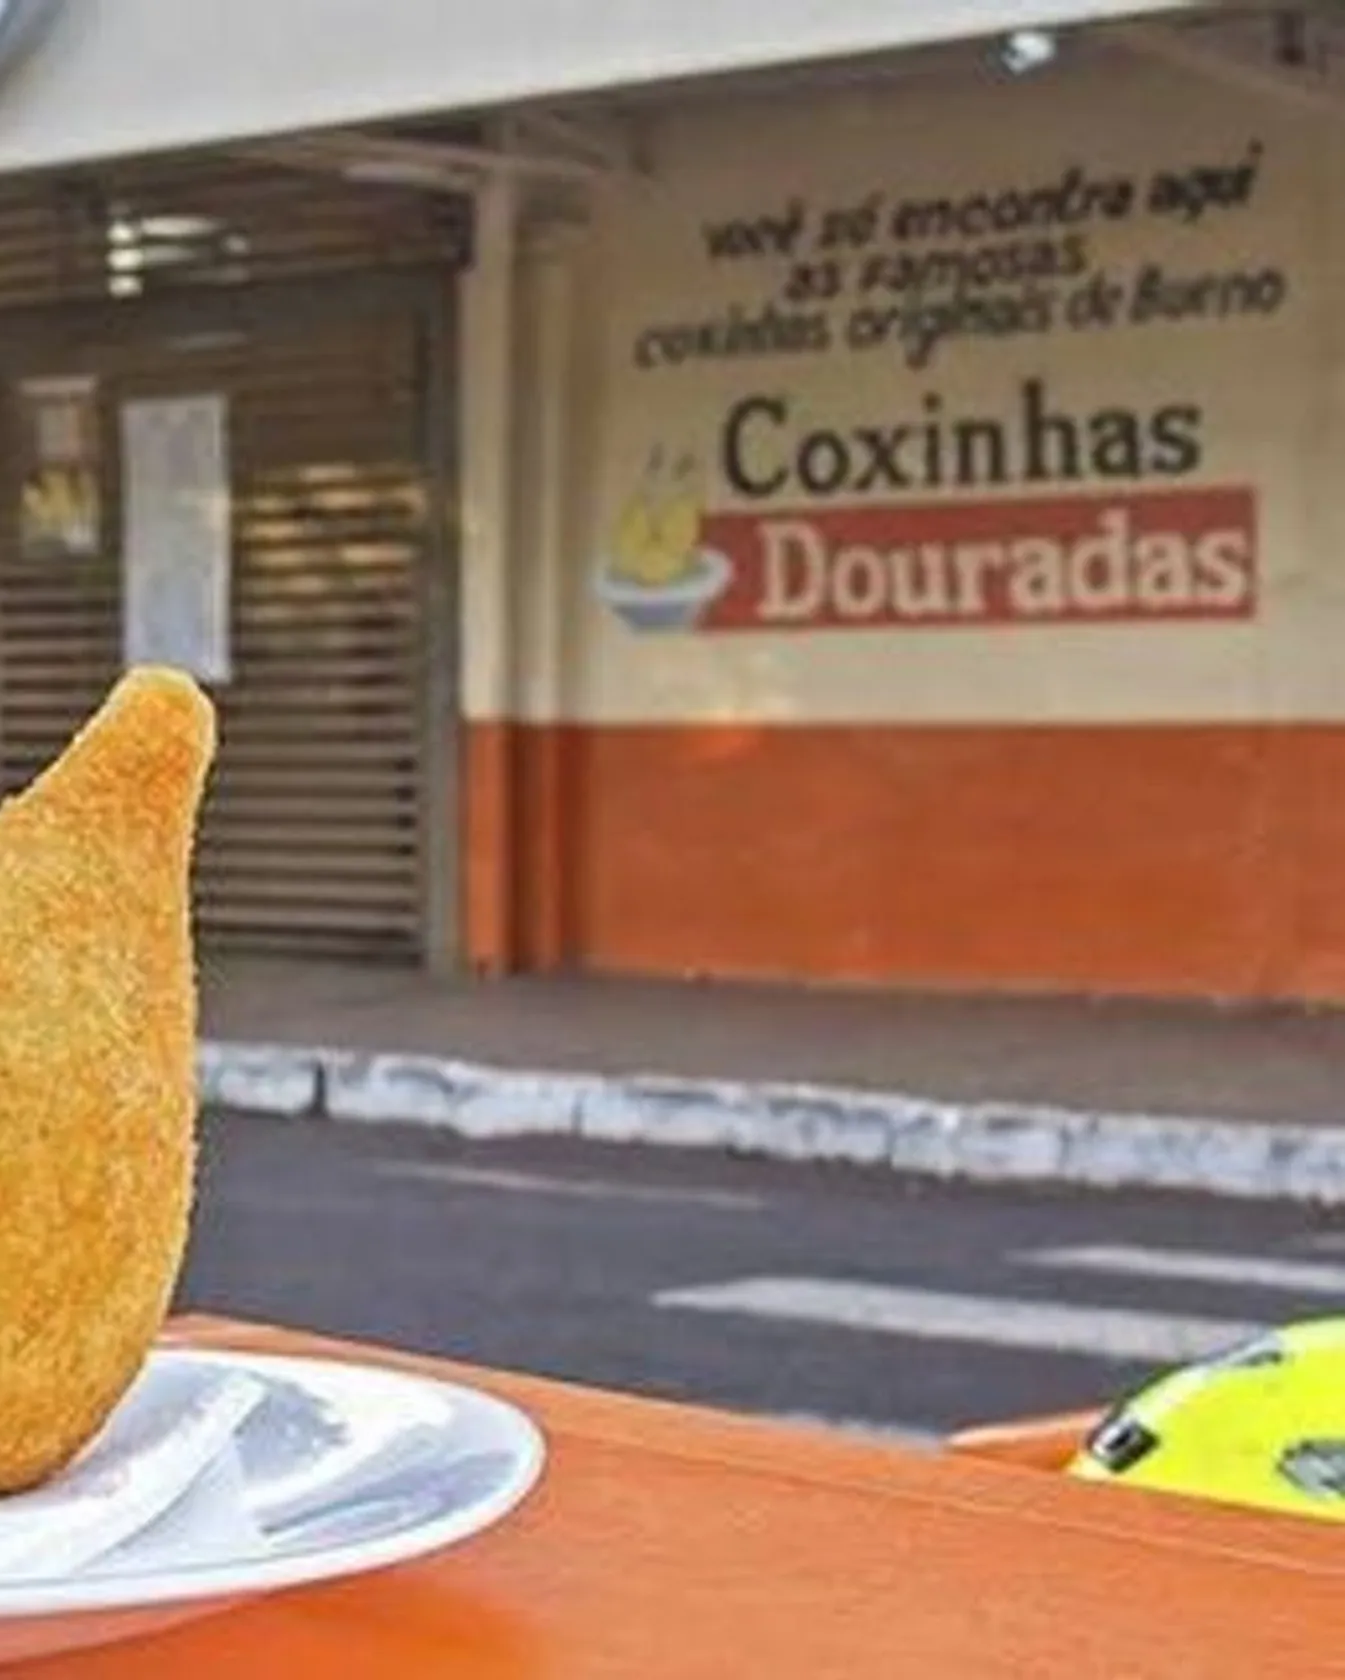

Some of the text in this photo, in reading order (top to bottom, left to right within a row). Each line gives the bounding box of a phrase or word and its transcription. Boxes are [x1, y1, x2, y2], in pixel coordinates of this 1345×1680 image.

[893, 164, 1133, 240] encontra
[1150, 139, 1264, 225] aqui
[724, 379, 1203, 498] Coxinhas
[757, 510, 1249, 622] Douradas
